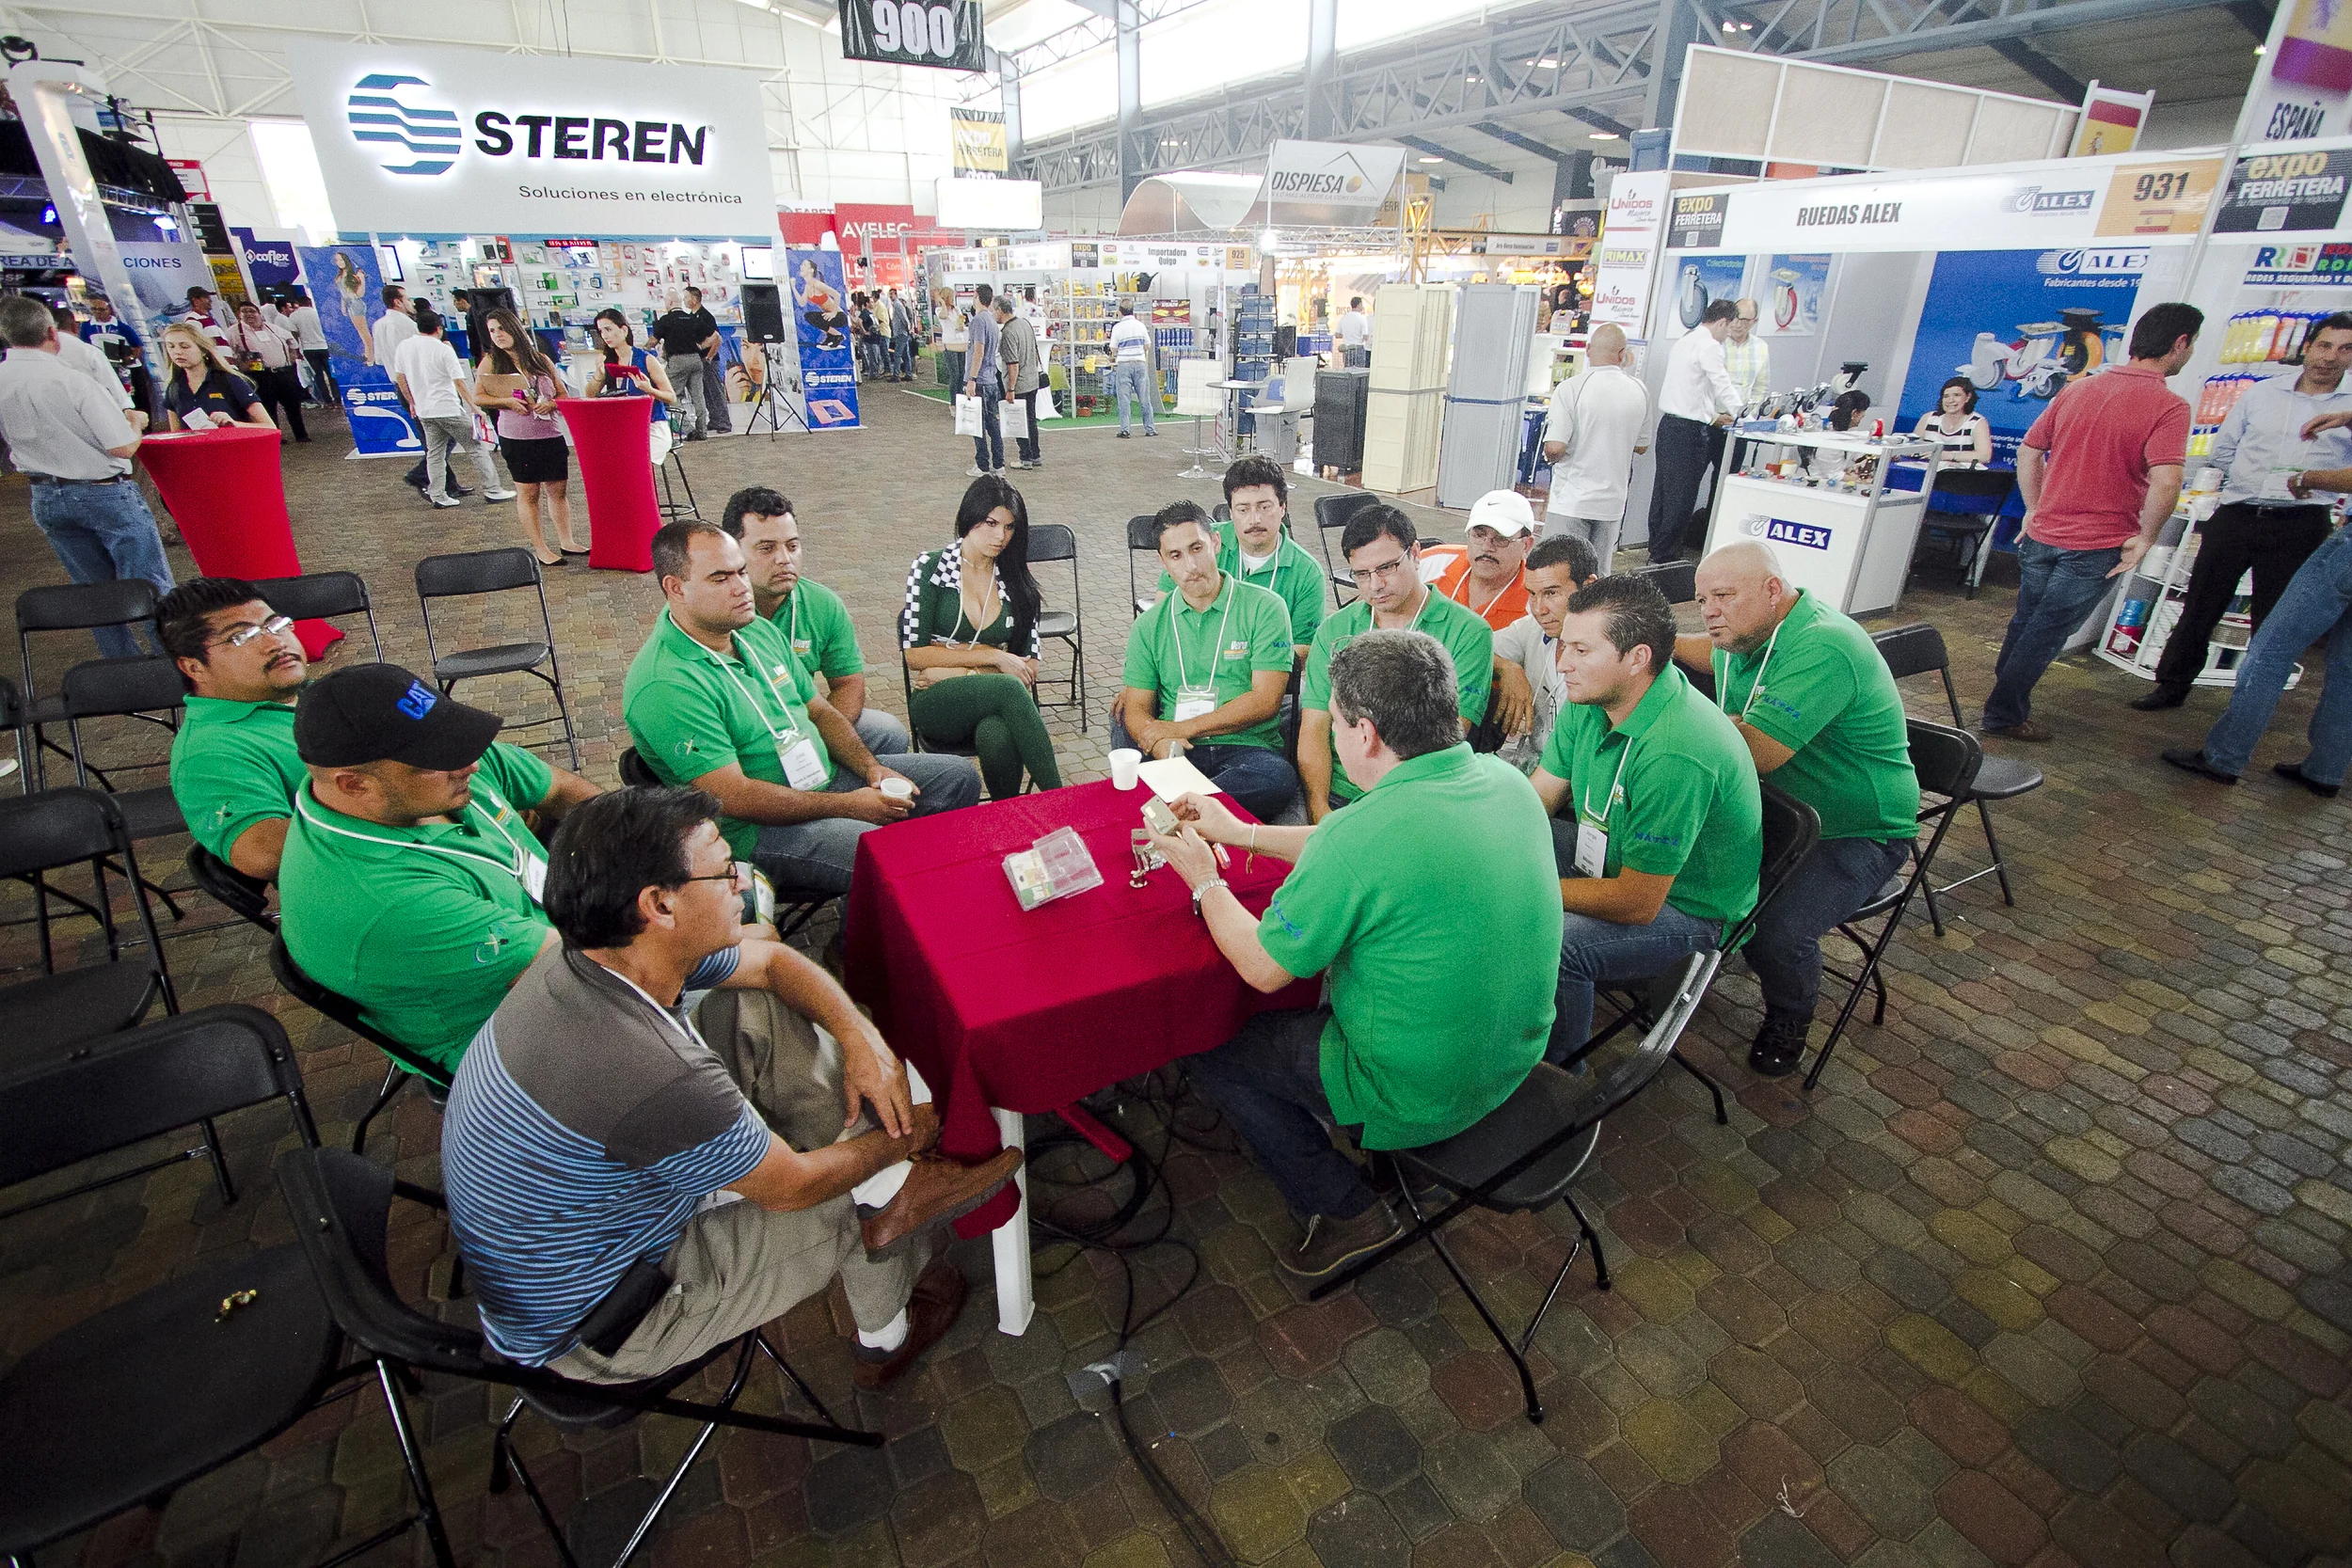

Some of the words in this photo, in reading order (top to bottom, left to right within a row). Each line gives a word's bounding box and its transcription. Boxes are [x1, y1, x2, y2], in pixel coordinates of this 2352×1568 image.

[872, 0, 955, 58] 900
[2265, 99, 2326, 140] ESPAÑA
[474, 111, 706, 166] STEREN
[2248, 151, 2329, 182] expo
[1272, 171, 1344, 194] DISPIESA
[2133, 172, 2190, 201] 931
[2238, 176, 2345, 199] FERRETERA
[519, 185, 619, 201] Soluciones
[626, 191, 645, 202] en
[651, 189, 742, 204] electrónica
[2035, 194, 2090, 209] ALEX
[1611, 198, 1653, 210] UNIDOS
[1678, 196, 1714, 214] expo
[1675, 213, 1722, 226] FERRETERA
[1796, 203, 1859, 227] RUEDAS
[1860, 201, 1902, 225] ALEX
[256, 250, 290, 264] coflex
[1148, 247, 1187, 258] Importadora
[1232, 249, 1245, 259] 925
[1604, 250, 1645, 262] RIMAX
[37, 256, 58, 267] DE
[63, 257, 76, 267] A
[1158, 256, 1177, 266] Quigo
[2044, 277, 2096, 288] Fabricantes
[2098, 277, 2129, 288] desde
[2246, 273, 2274, 283] REDES
[2276, 273, 2332, 283] SEGURIDAD
[1596, 293, 1635, 306] UNIDOS
[819, 374, 852, 384] STEREN
[367, 390, 398, 402] STER
[1770, 522, 1828, 547] ALEX
[396, 678, 437, 721] CAT
